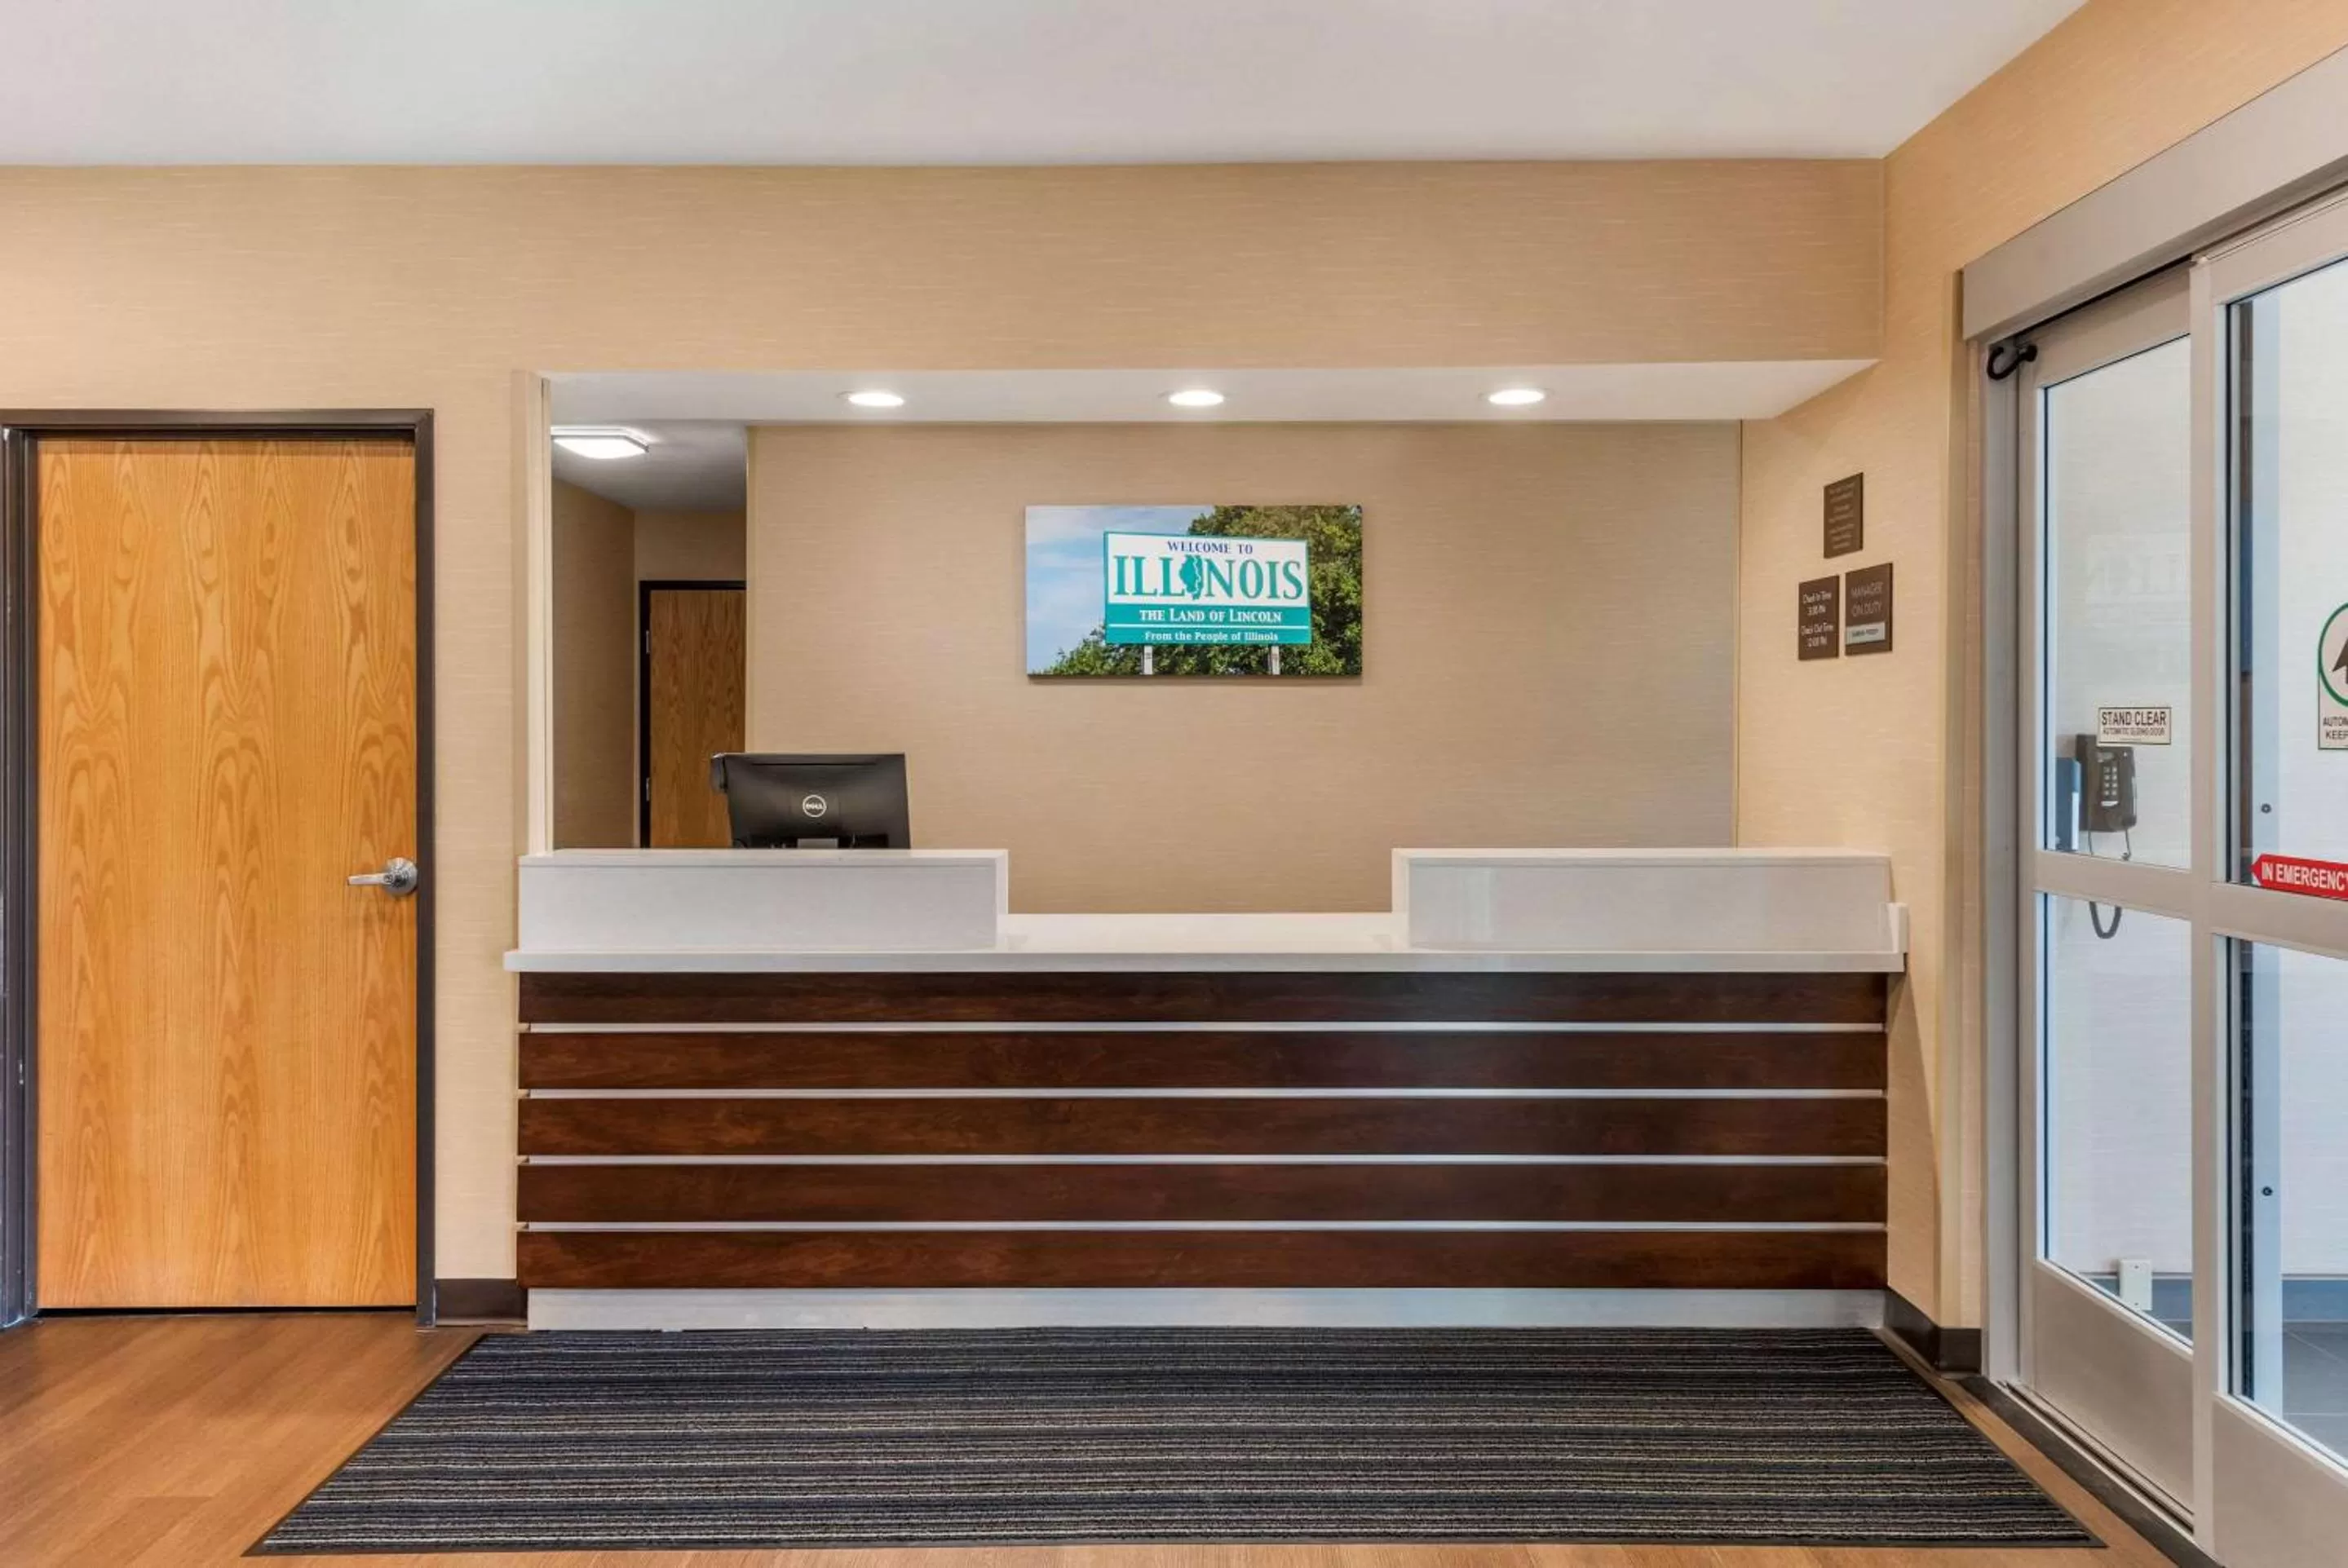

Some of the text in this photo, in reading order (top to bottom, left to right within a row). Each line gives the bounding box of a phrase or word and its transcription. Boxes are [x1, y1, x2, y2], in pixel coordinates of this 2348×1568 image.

[1167, 541, 1254, 554] WELCOME TO
[1139, 607, 1283, 623] THE LAND OF LINCOLN
[1145, 631, 1278, 643] From the People of Illinois
[2102, 711, 2167, 726] STAND CLEAR
[2262, 862, 2274, 881] IN
